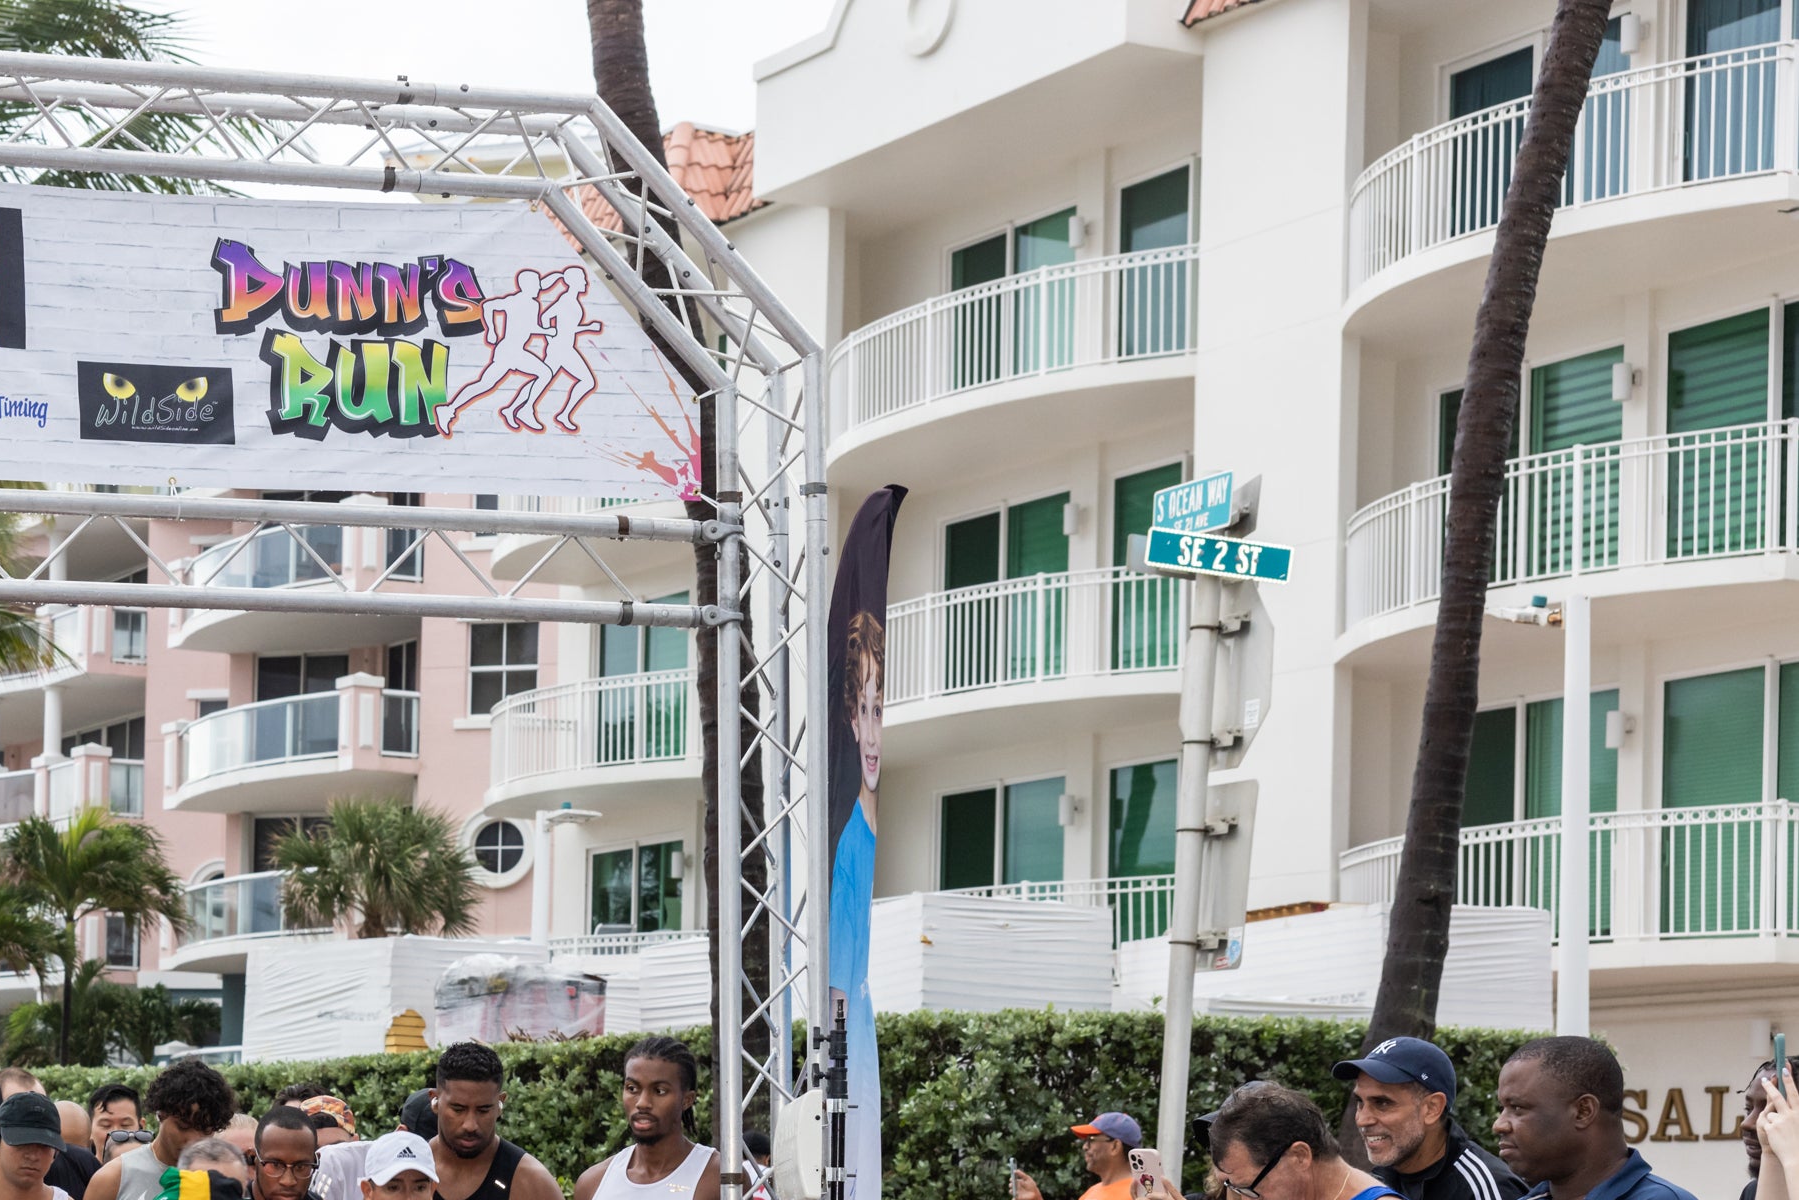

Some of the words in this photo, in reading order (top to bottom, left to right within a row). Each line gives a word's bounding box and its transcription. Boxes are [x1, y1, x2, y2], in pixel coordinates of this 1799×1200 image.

[259, 327, 450, 441] RUN
[1156, 494, 1165, 522] S
[1168, 482, 1204, 519] OCEAN
[1207, 476, 1229, 507] WAY
[1194, 512, 1210, 528] AVE
[1177, 536, 1205, 567] SE
[1212, 541, 1228, 570] 2
[1235, 545, 1263, 575] ST
